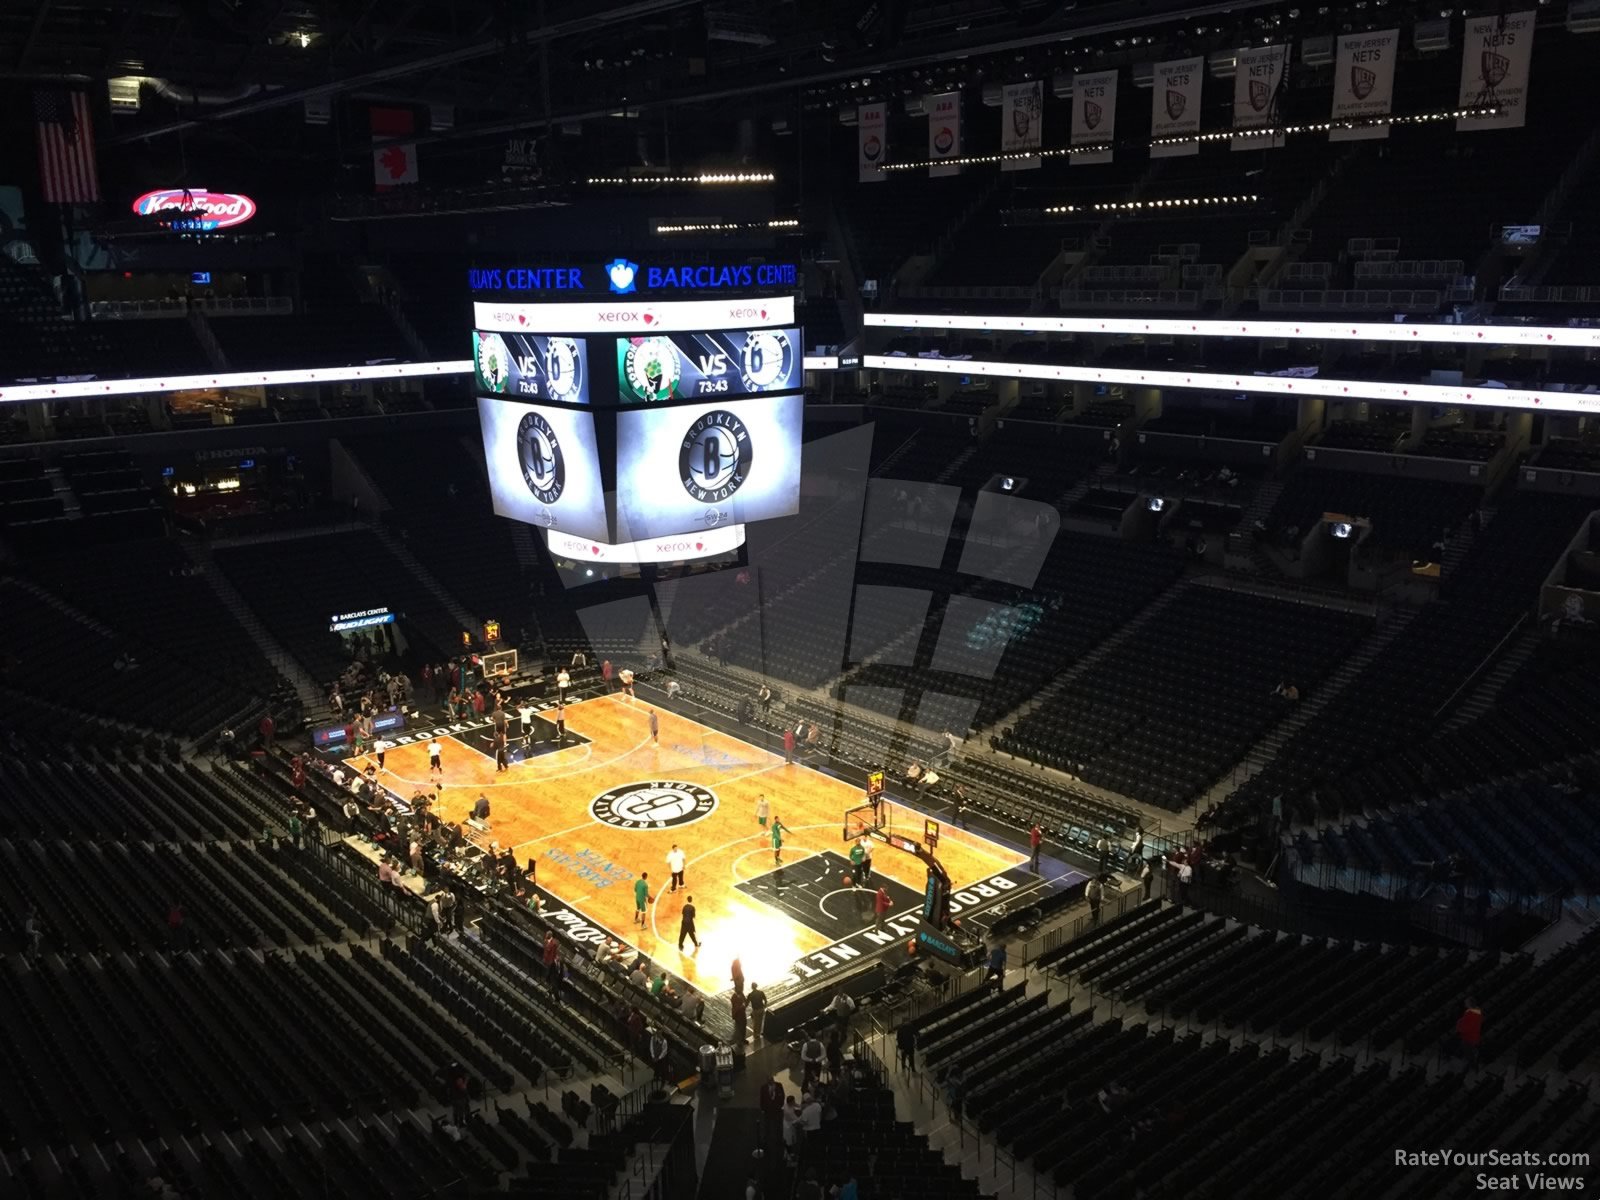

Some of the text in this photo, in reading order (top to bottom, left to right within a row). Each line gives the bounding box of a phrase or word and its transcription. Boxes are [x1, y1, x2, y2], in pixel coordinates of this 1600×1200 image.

[1345, 38, 1392, 50] NEW JERSEY
[1483, 33, 1515, 47] NETS
[1242, 52, 1284, 65] NEW JERSEY
[1352, 49, 1381, 63] NETS
[1249, 64, 1274, 76] NETS
[1166, 75, 1189, 87] NETS
[1084, 87, 1105, 98] NETS
[506, 268, 585, 289] CENTER
[648, 265, 752, 288] BARCLAYS
[598, 311, 639, 322] xerox
[730, 306, 758, 319] xerox
[518, 355, 537, 378] VS
[699, 353, 727, 377] VS
[699, 380, 729, 393] 73:43
[518, 415, 558, 449] BROOKLYN
[683, 413, 747, 449] BROOKLYN
[209, 446, 267, 459] HONDA
[703, 436, 720, 480] B
[543, 481, 562, 502] YORK
[683, 474, 743, 501] NEW YORK
[656, 541, 692, 553] xerox
[340, 607, 388, 620] BARCLAYS CENTER
[383, 711, 514, 750] BROOKL
[650, 781, 698, 793] YORK
[595, 794, 667, 828] BROOKLYN
[695, 794, 712, 812] NEW
[863, 876, 1018, 945] BROOLYN
[926, 935, 957, 957] BARCLAYS
